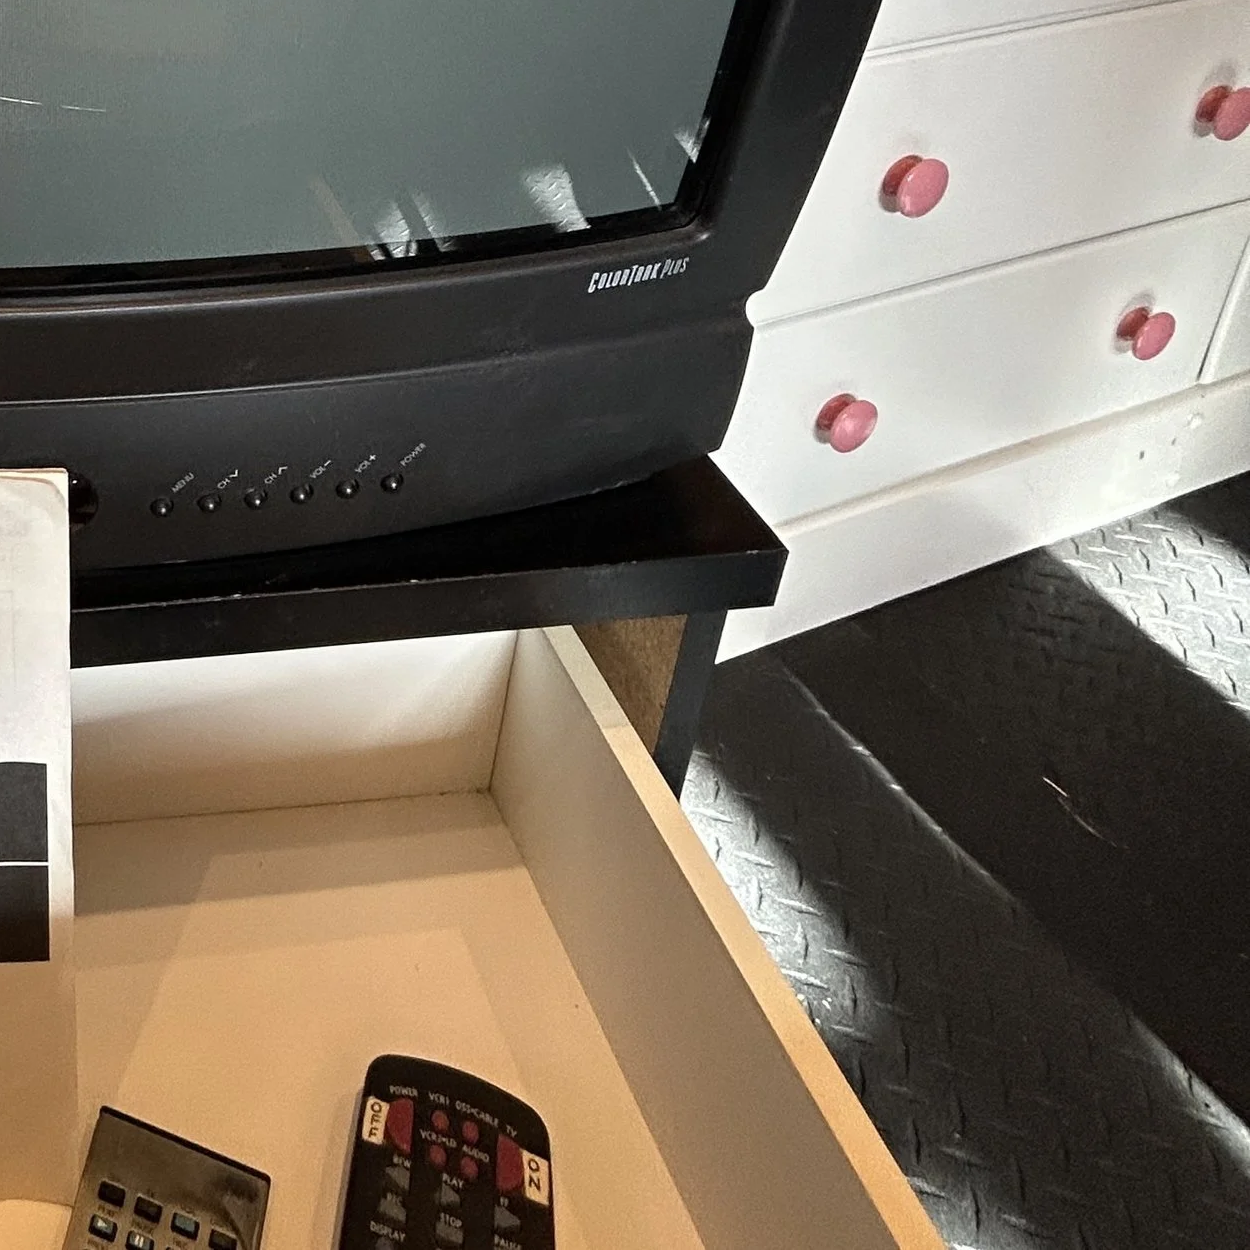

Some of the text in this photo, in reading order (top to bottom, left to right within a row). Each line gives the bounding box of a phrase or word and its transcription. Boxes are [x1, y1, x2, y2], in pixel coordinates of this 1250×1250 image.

[172, 472, 195, 493] MENU
[389, 1085, 419, 1098] POWER
[368, 1101, 383, 1139] OFF
[506, 1124, 518, 1138] TV
[461, 1144, 490, 1163] AUDIO
[442, 1172, 464, 1190] PLAY
[528, 1158, 541, 1192] ON
[439, 1212, 463, 1229] STOP
[369, 1219, 406, 1243] DISPLAY
